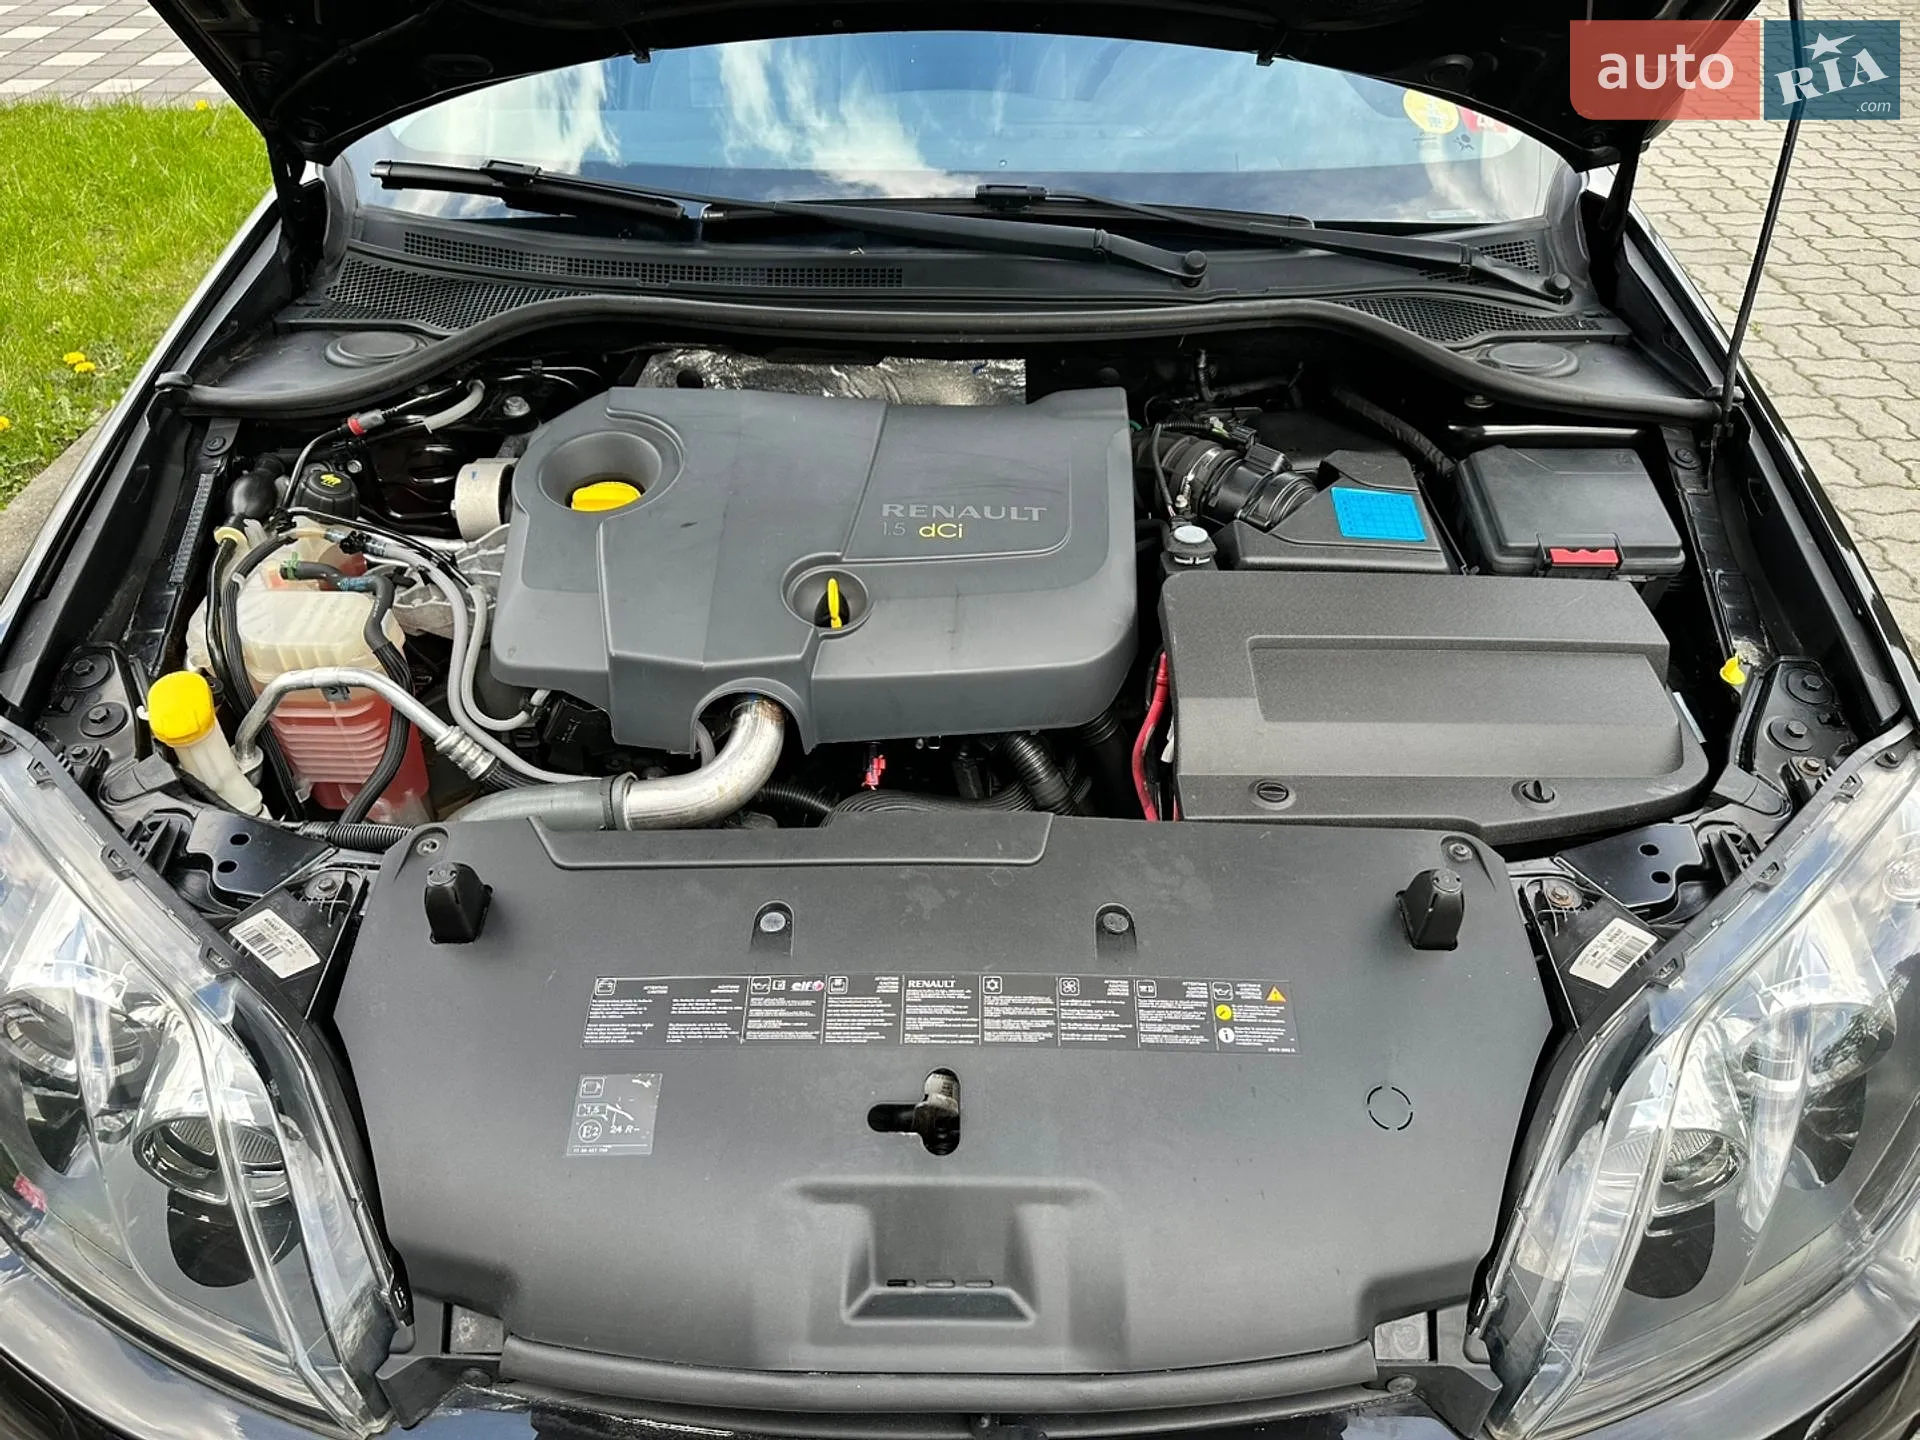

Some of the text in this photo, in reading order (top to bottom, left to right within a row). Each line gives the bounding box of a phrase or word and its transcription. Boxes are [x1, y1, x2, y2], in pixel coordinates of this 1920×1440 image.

[881, 503, 1048, 522] RENAULT
[882, 522, 964, 539] 1.5 dCi
[908, 979, 957, 988] RENAULT
